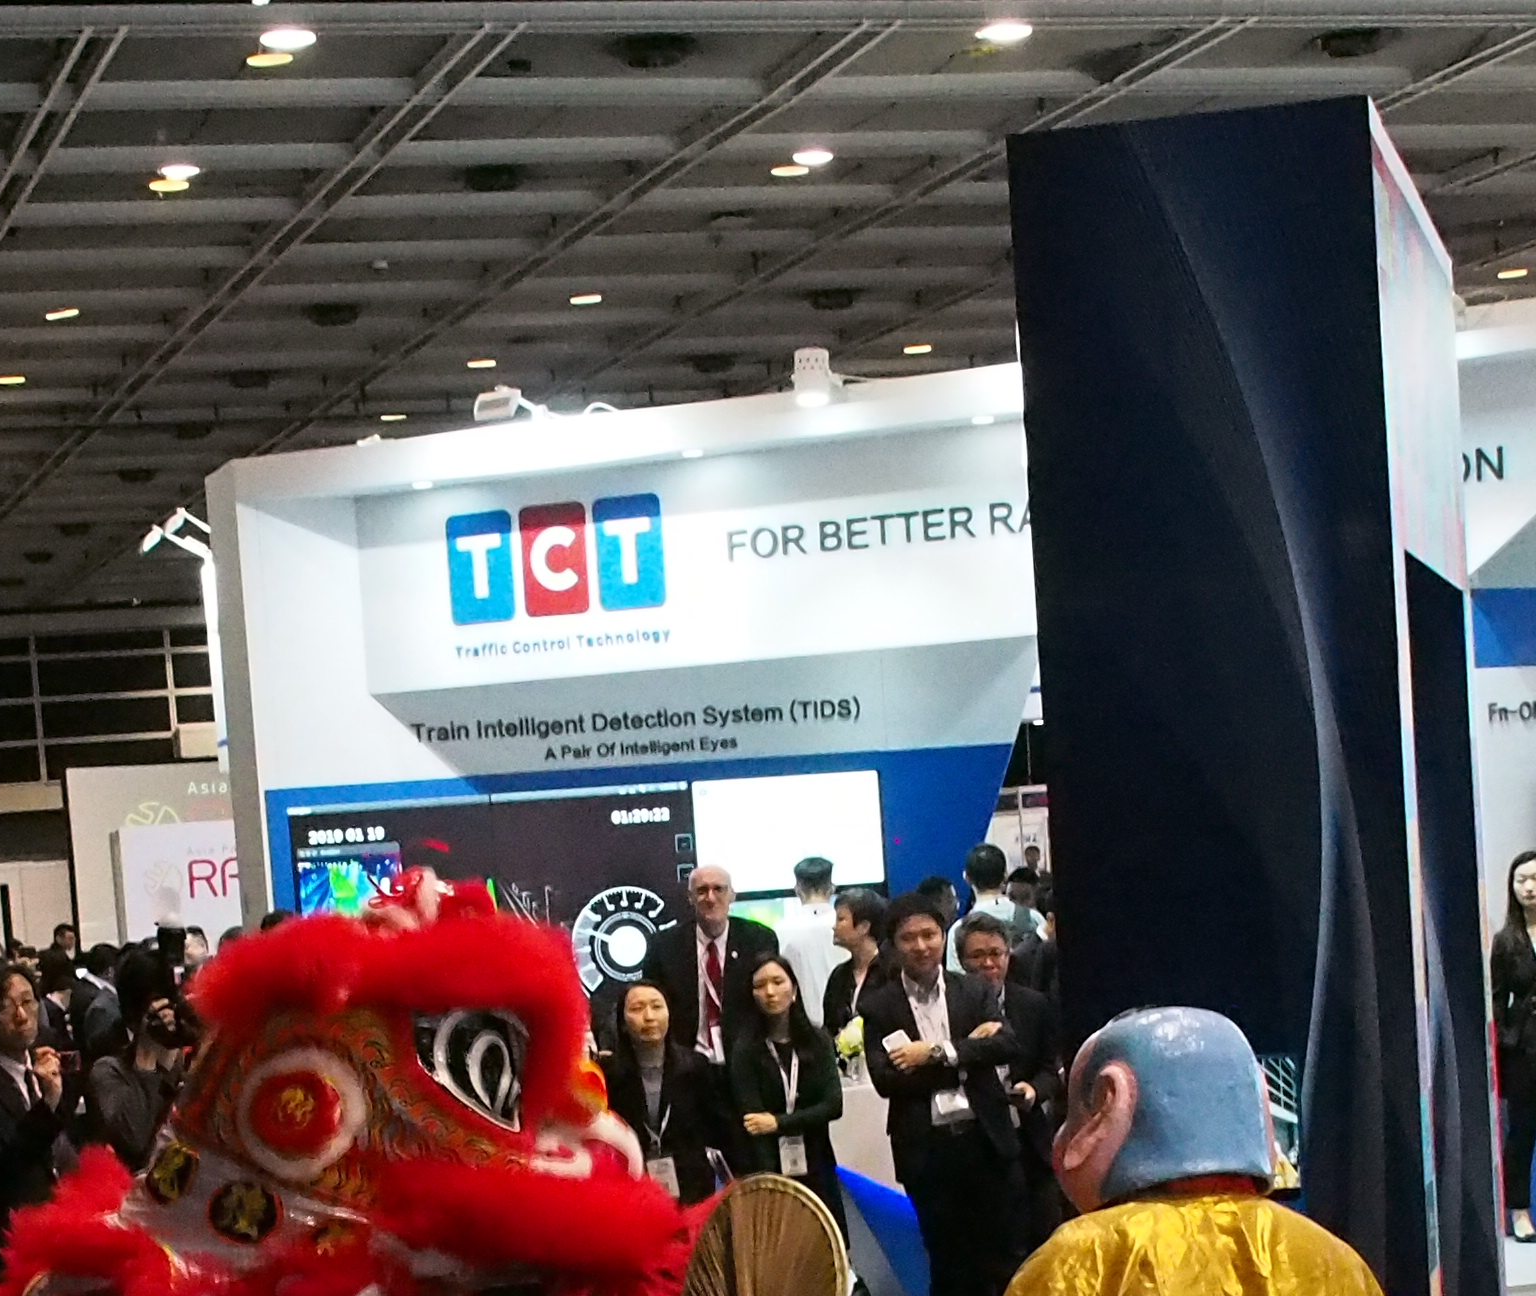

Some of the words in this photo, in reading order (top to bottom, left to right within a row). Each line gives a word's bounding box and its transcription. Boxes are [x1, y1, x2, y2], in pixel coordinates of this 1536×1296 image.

[726, 524, 808, 562] FOR
[818, 506, 977, 552] BETTER
[454, 515, 654, 602] TCT
[456, 643, 508, 660] Traffic
[512, 636, 571, 656] Control
[576, 628, 672, 650] Technology
[411, 723, 470, 743] Train
[476, 712, 585, 740] Intelligent
[592, 708, 696, 733] Detection
[703, 702, 784, 730] System
[789, 696, 862, 723] (TIDS)
[544, 747, 557, 761] A
[563, 744, 591, 760] Pair
[597, 742, 615, 758] Of
[620, 738, 695, 757] Intelligent
[700, 736, 738, 754] Eyes
[187, 781, 229, 795] Asia
